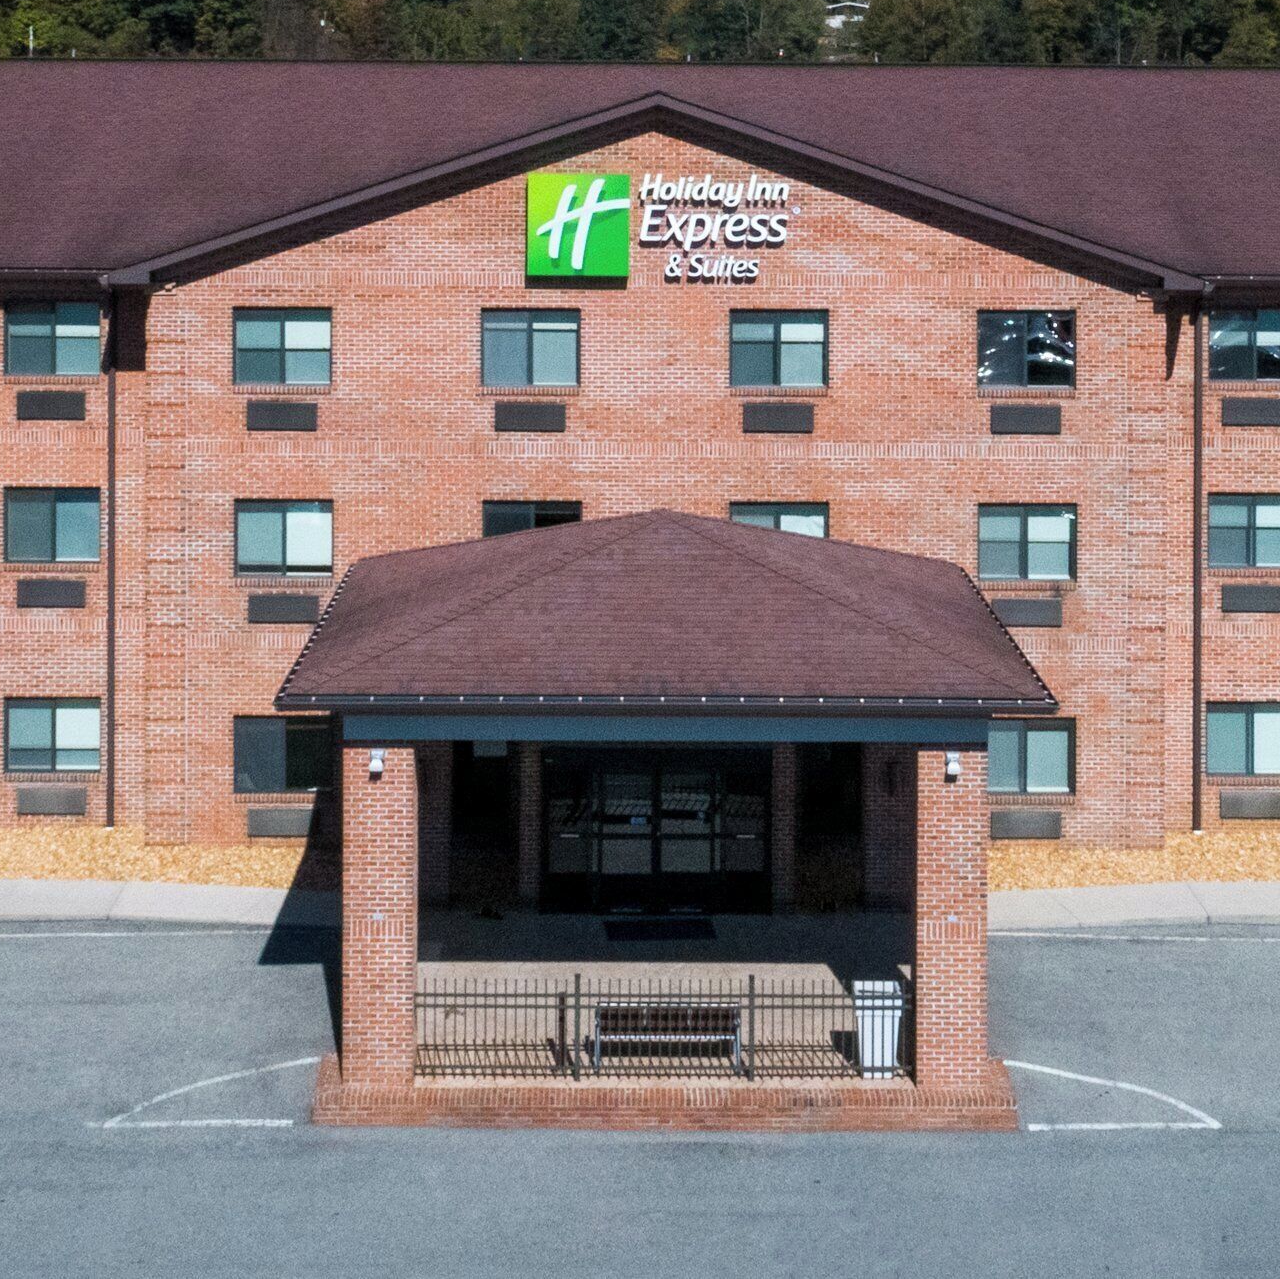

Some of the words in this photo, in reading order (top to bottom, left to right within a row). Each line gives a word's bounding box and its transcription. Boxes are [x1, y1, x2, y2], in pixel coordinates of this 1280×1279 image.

[639, 173, 744, 207] Holiday
[746, 174, 790, 201] Inn
[536, 178, 630, 270] H
[639, 204, 788, 252] Express
[664, 254, 682, 277] &
[687, 254, 760, 278] Suites
